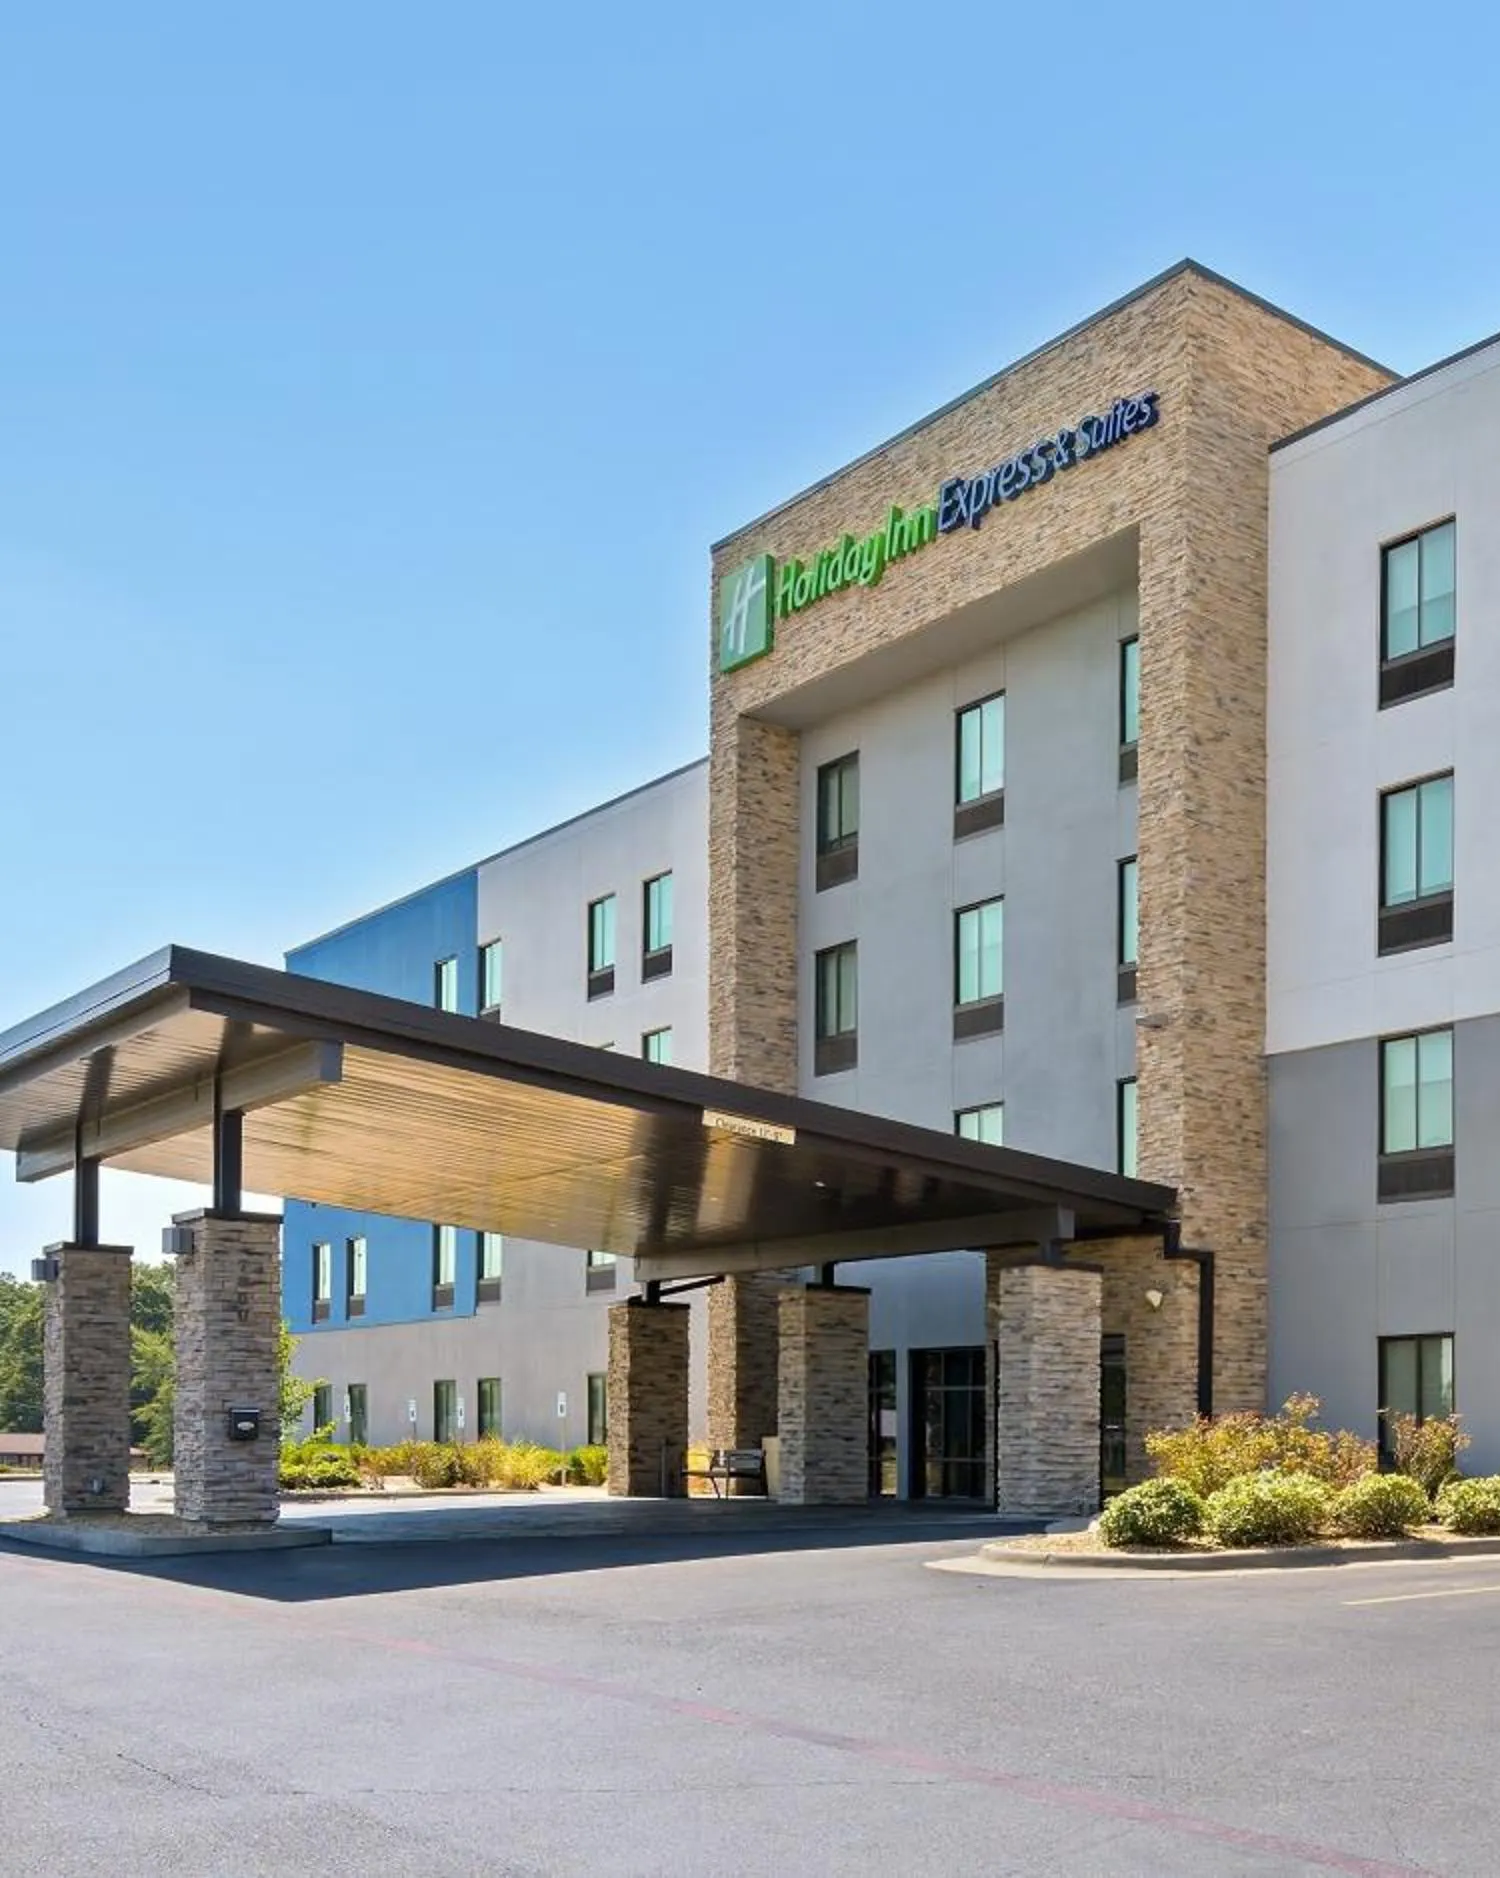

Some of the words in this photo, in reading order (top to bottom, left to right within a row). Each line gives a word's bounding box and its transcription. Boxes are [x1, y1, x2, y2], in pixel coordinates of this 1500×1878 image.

[775, 532, 885, 618] Holiday
[884, 504, 937, 562] Inn
[938, 437, 1055, 532] Express
[1053, 427, 1077, 470] &
[1074, 391, 1160, 459] Suites
